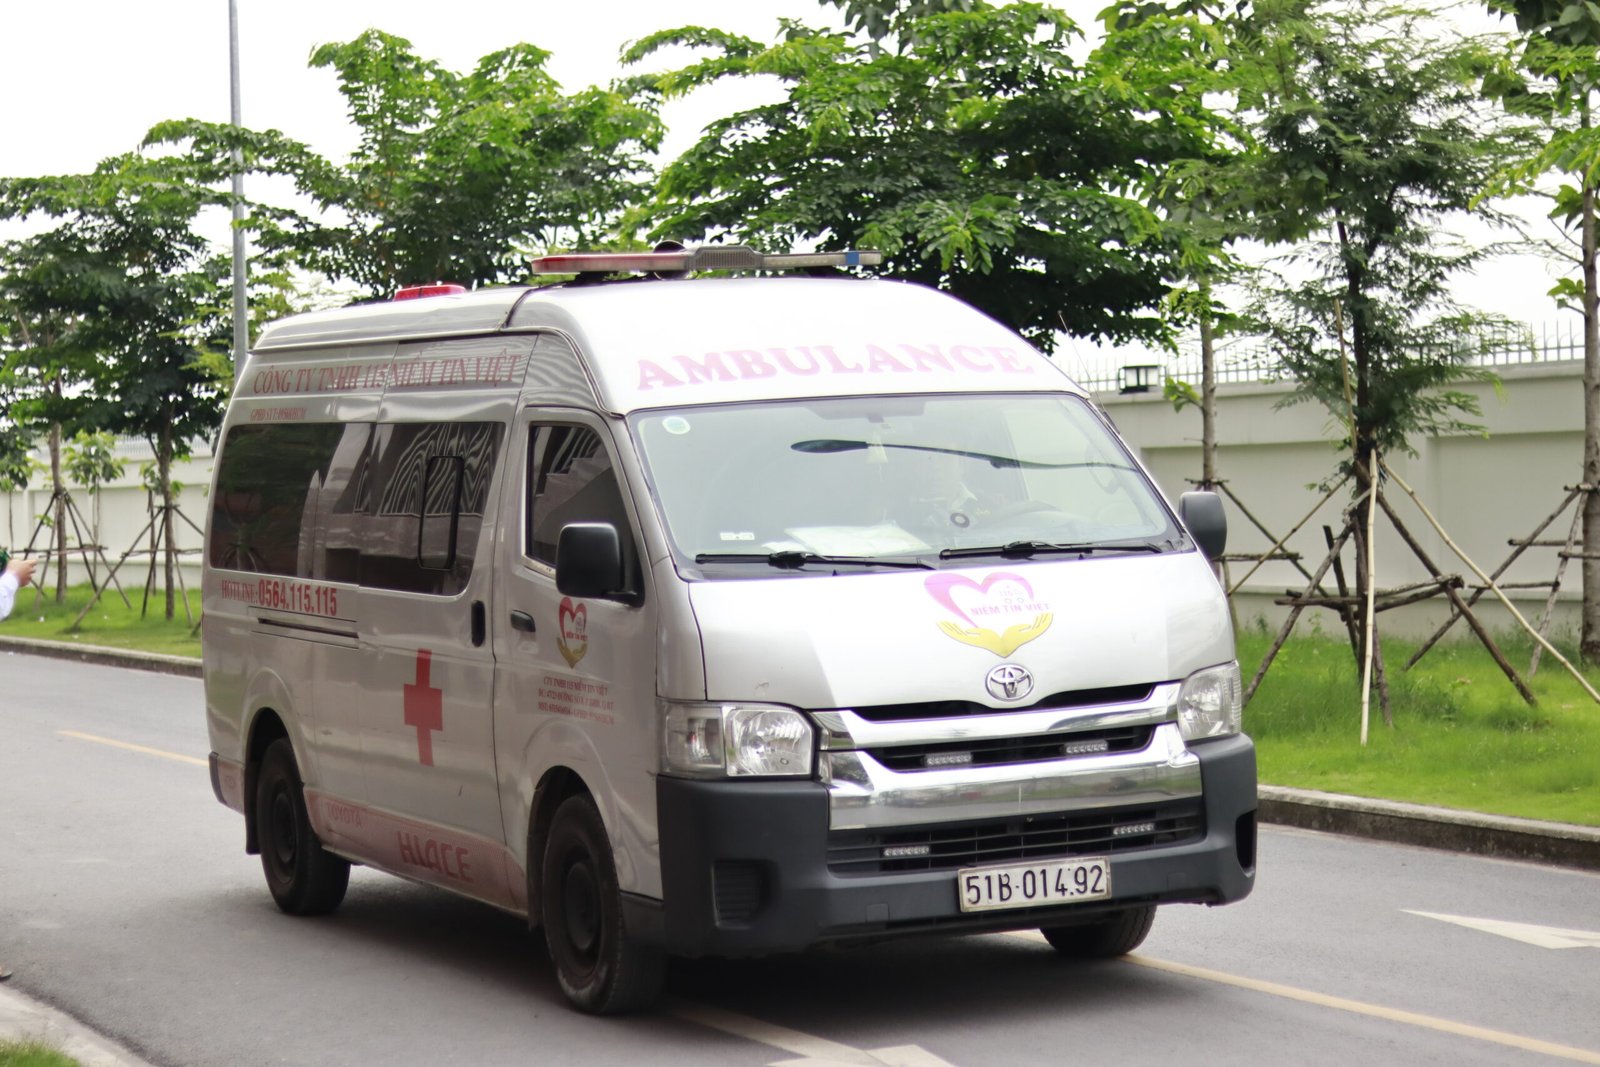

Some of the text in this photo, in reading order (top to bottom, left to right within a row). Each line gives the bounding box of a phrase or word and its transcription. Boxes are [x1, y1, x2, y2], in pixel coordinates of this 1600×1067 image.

[253, 364, 292, 394] CÔNG
[295, 367, 317, 393] TY
[318, 364, 362, 391] TNHH
[437, 357, 468, 385] TIN
[637, 343, 1034, 391] AMBULANCE
[258, 578, 337, 616] 0564.115.115
[1002, 603, 1022, 613] TIN
[397, 830, 473, 882] HIACE
